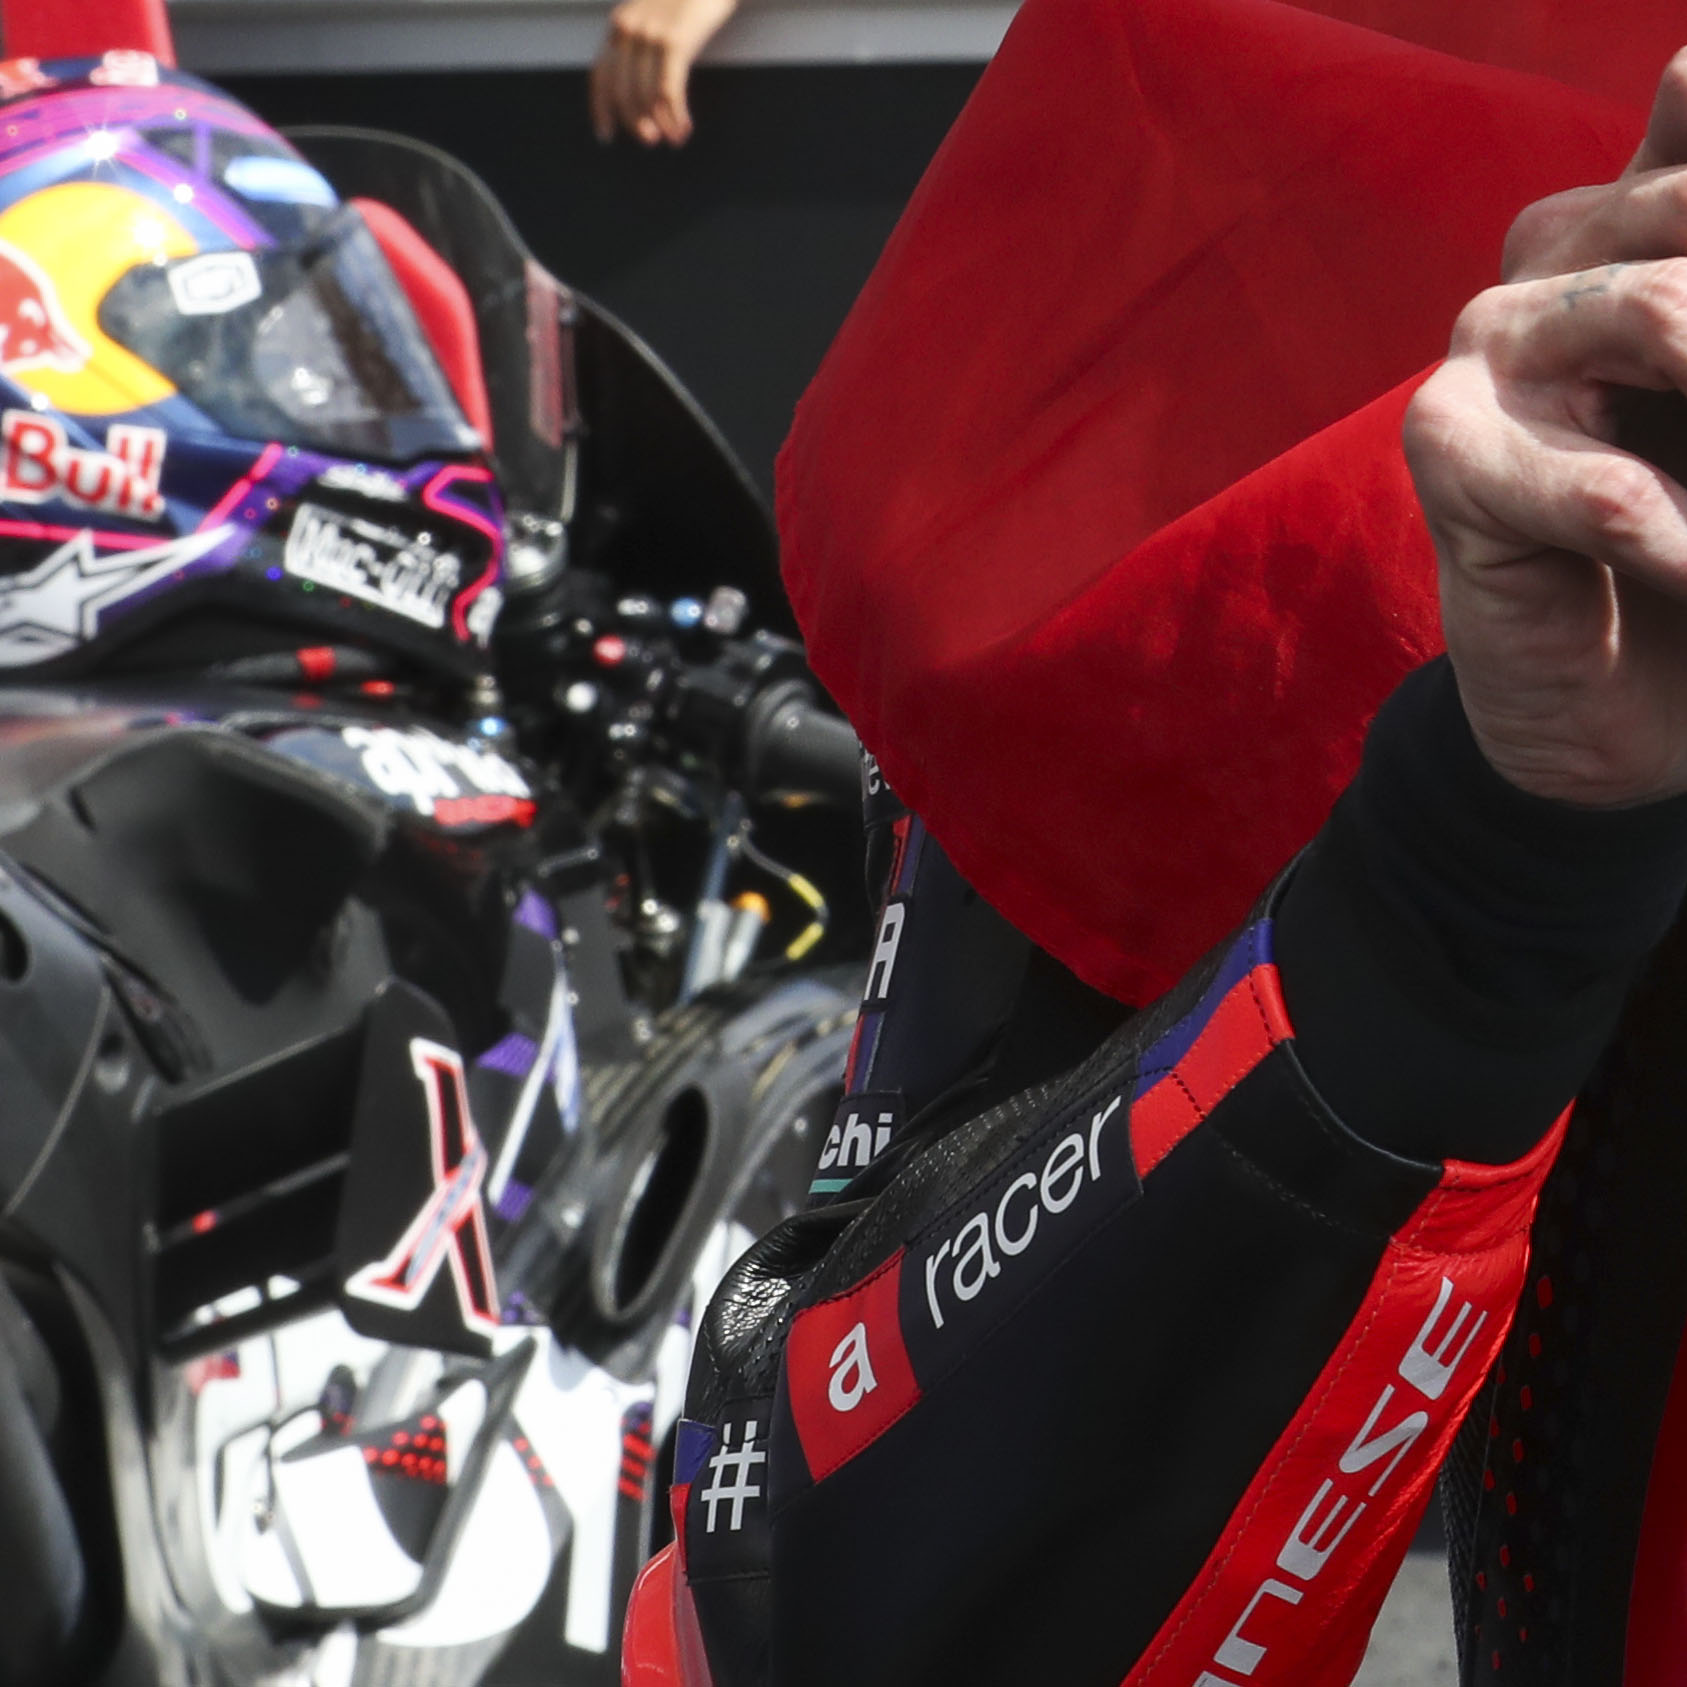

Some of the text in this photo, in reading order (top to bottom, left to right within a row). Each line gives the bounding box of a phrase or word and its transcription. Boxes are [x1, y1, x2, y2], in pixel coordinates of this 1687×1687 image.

[2, 410, 167, 520] Bull
[826, 1321, 879, 1413] a
[923, 1096, 1124, 1328] racer
[1190, 1276, 1489, 1687] NESE
